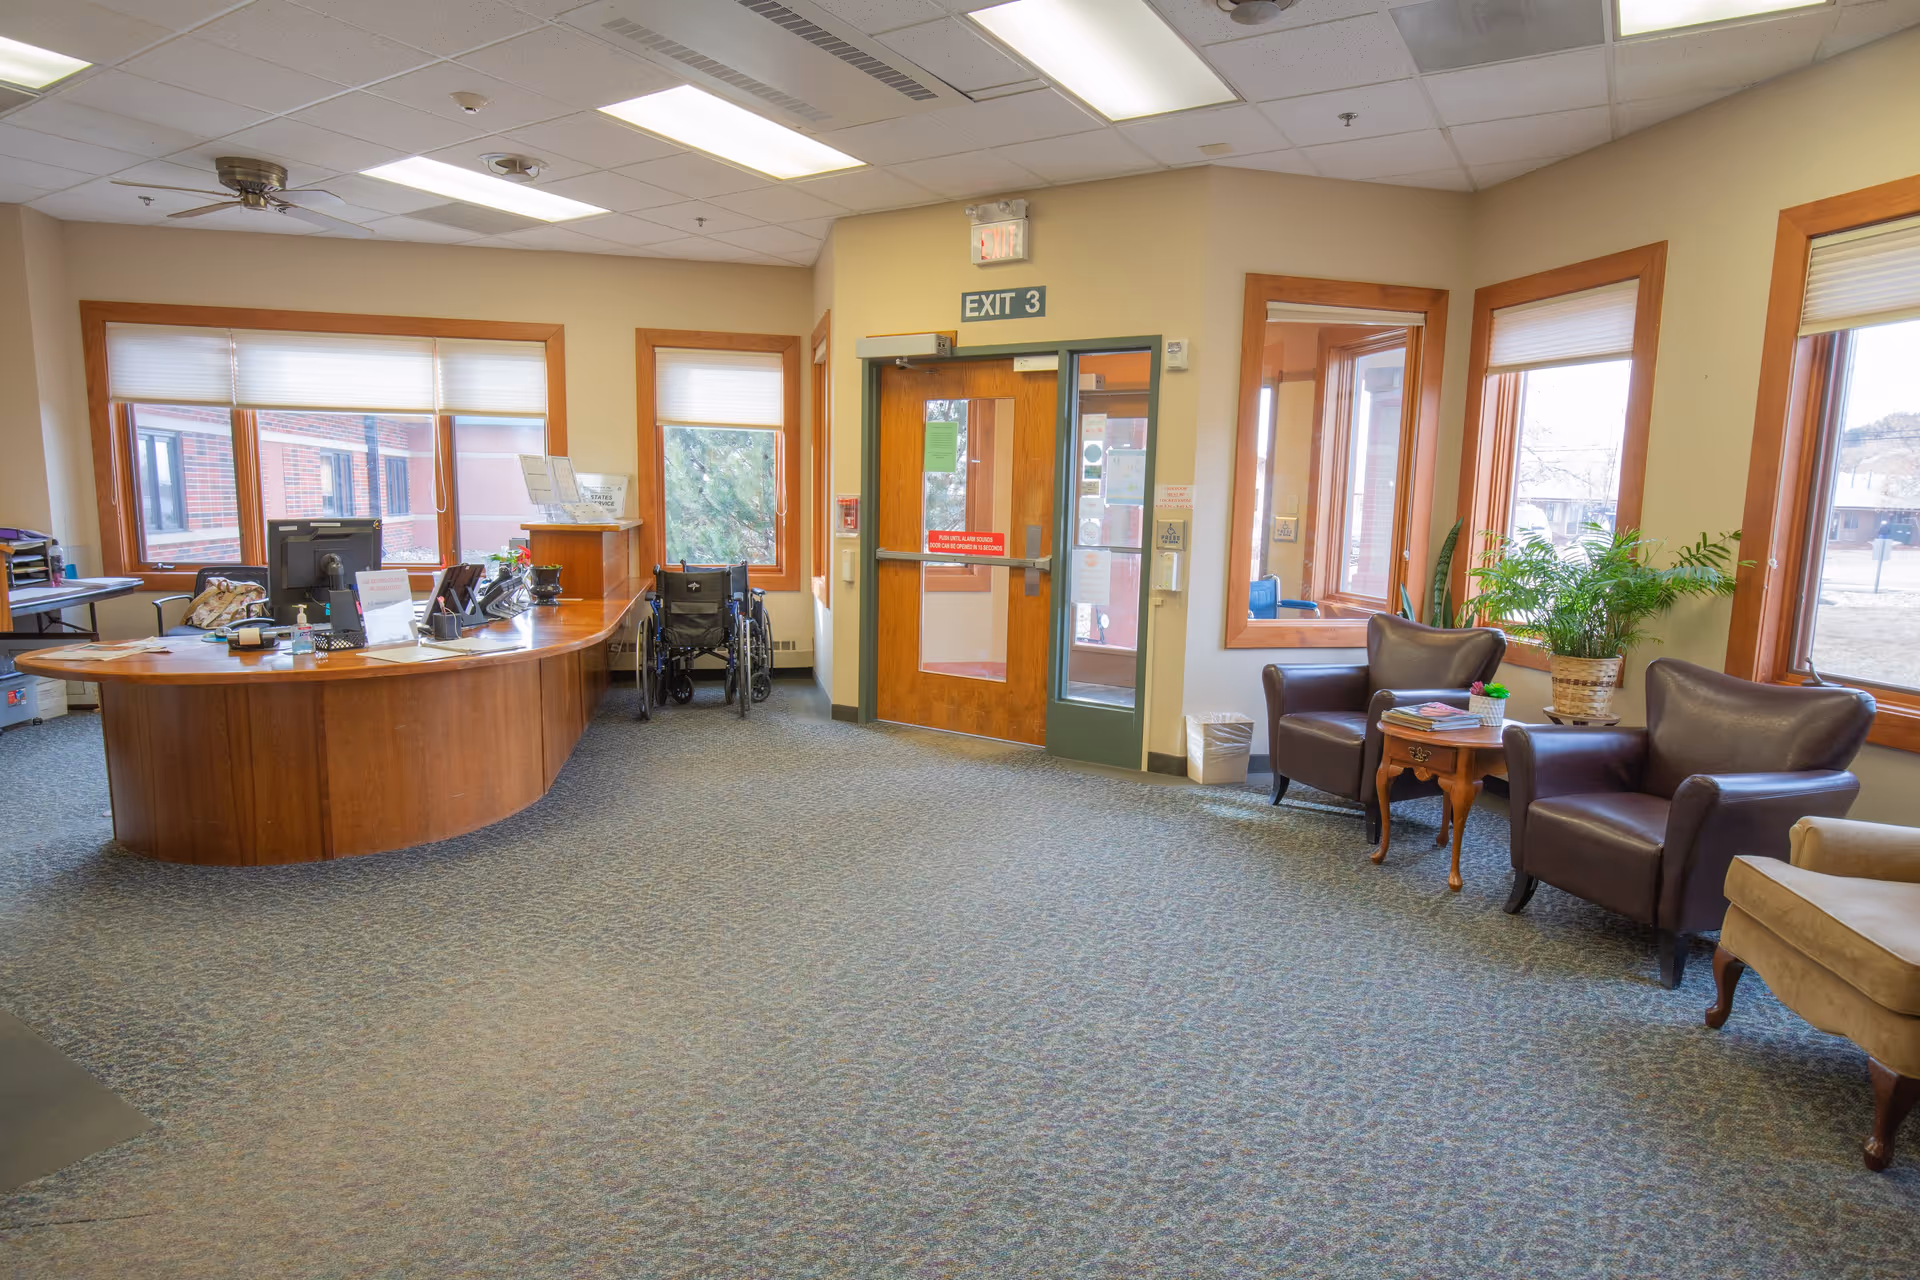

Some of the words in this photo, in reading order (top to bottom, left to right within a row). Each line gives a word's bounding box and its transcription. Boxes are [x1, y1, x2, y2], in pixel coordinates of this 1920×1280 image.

[981, 225, 1016, 260] EXIT
[966, 292, 1016, 317] EXIT
[1025, 290, 1041, 313] 3
